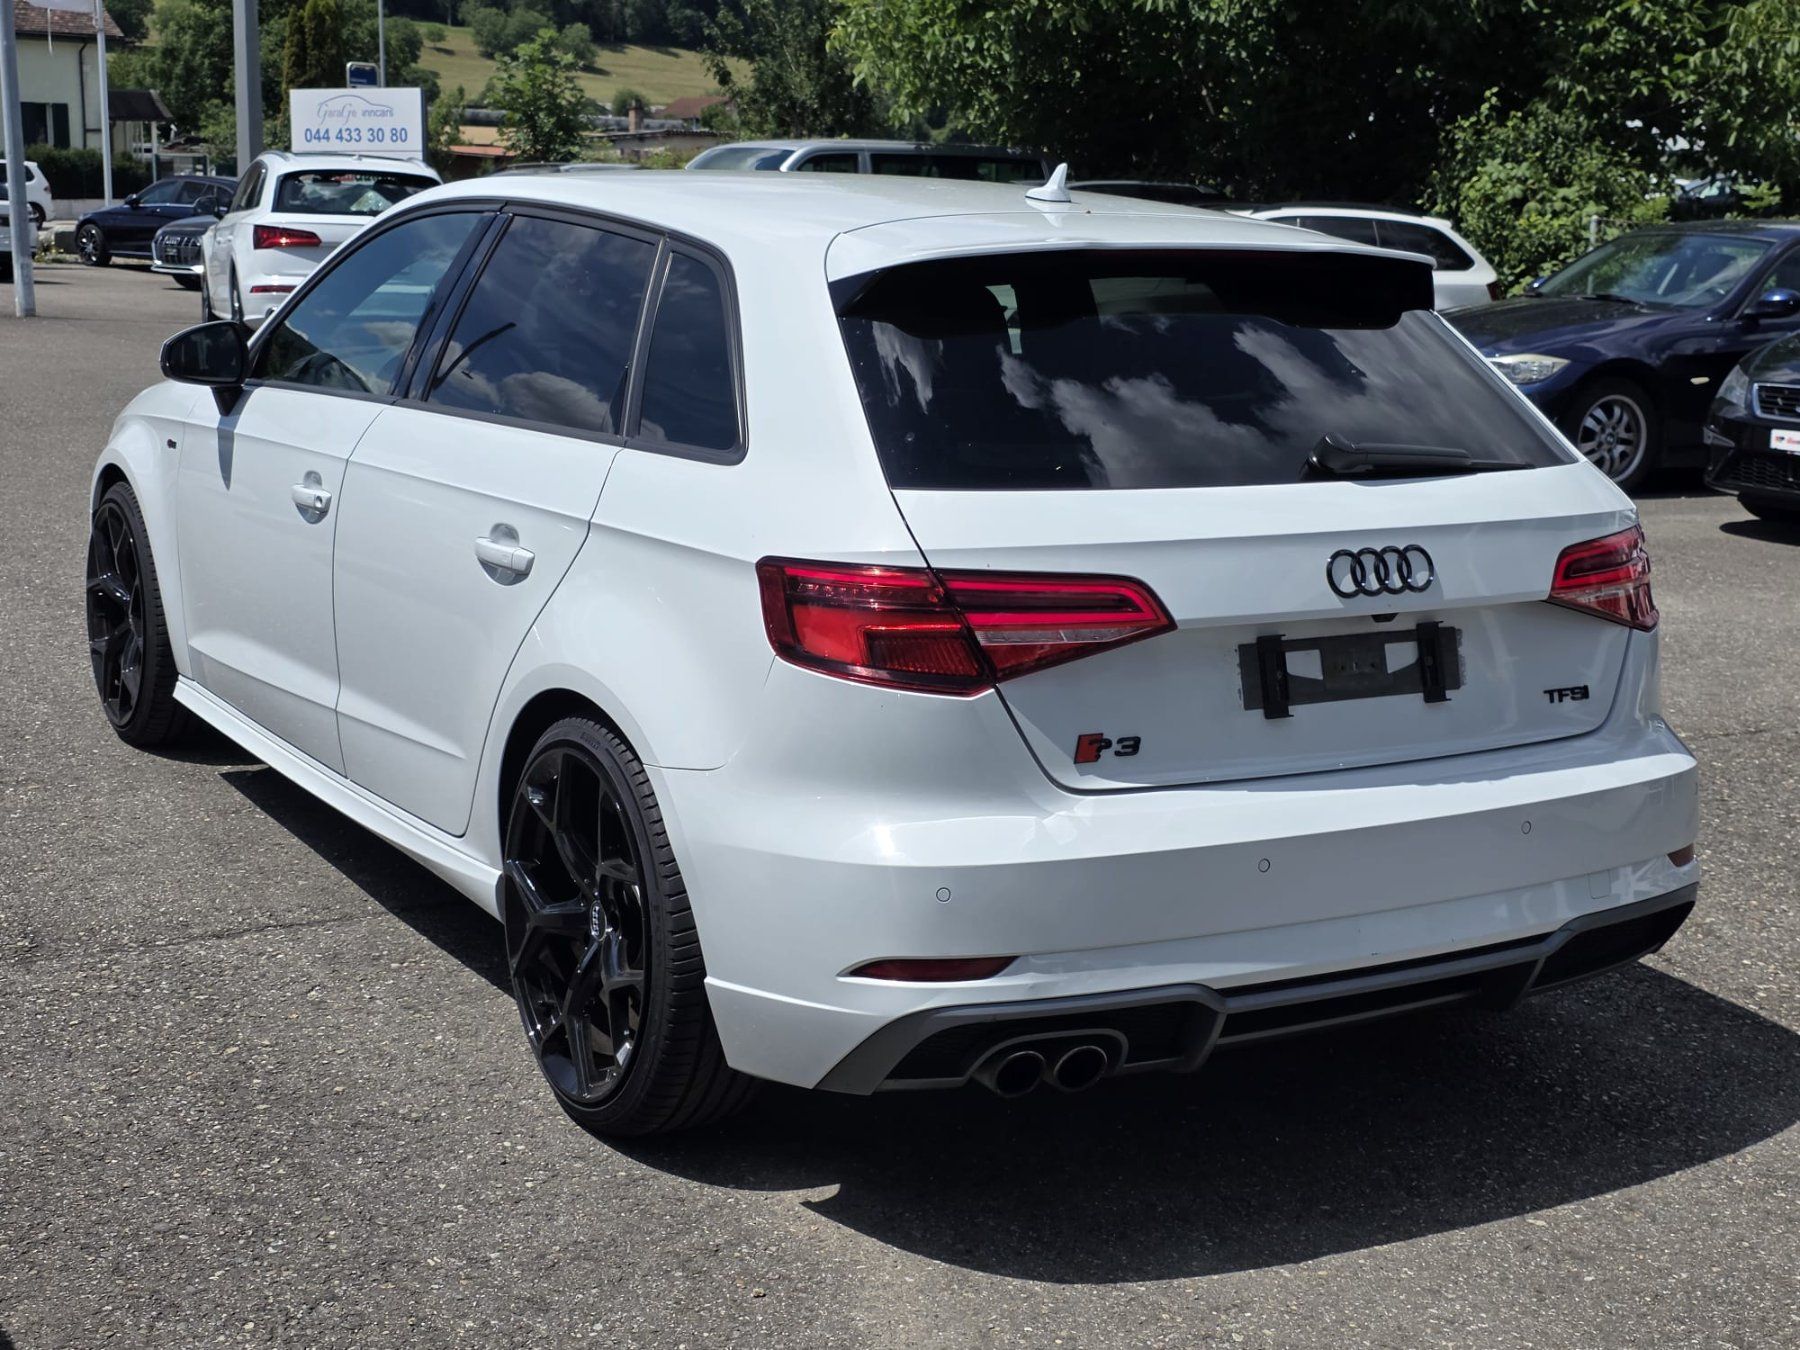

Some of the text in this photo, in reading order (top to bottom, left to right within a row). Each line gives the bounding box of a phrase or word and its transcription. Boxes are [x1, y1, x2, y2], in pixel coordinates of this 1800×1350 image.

[304, 128, 408, 143] 044 433 30 80
